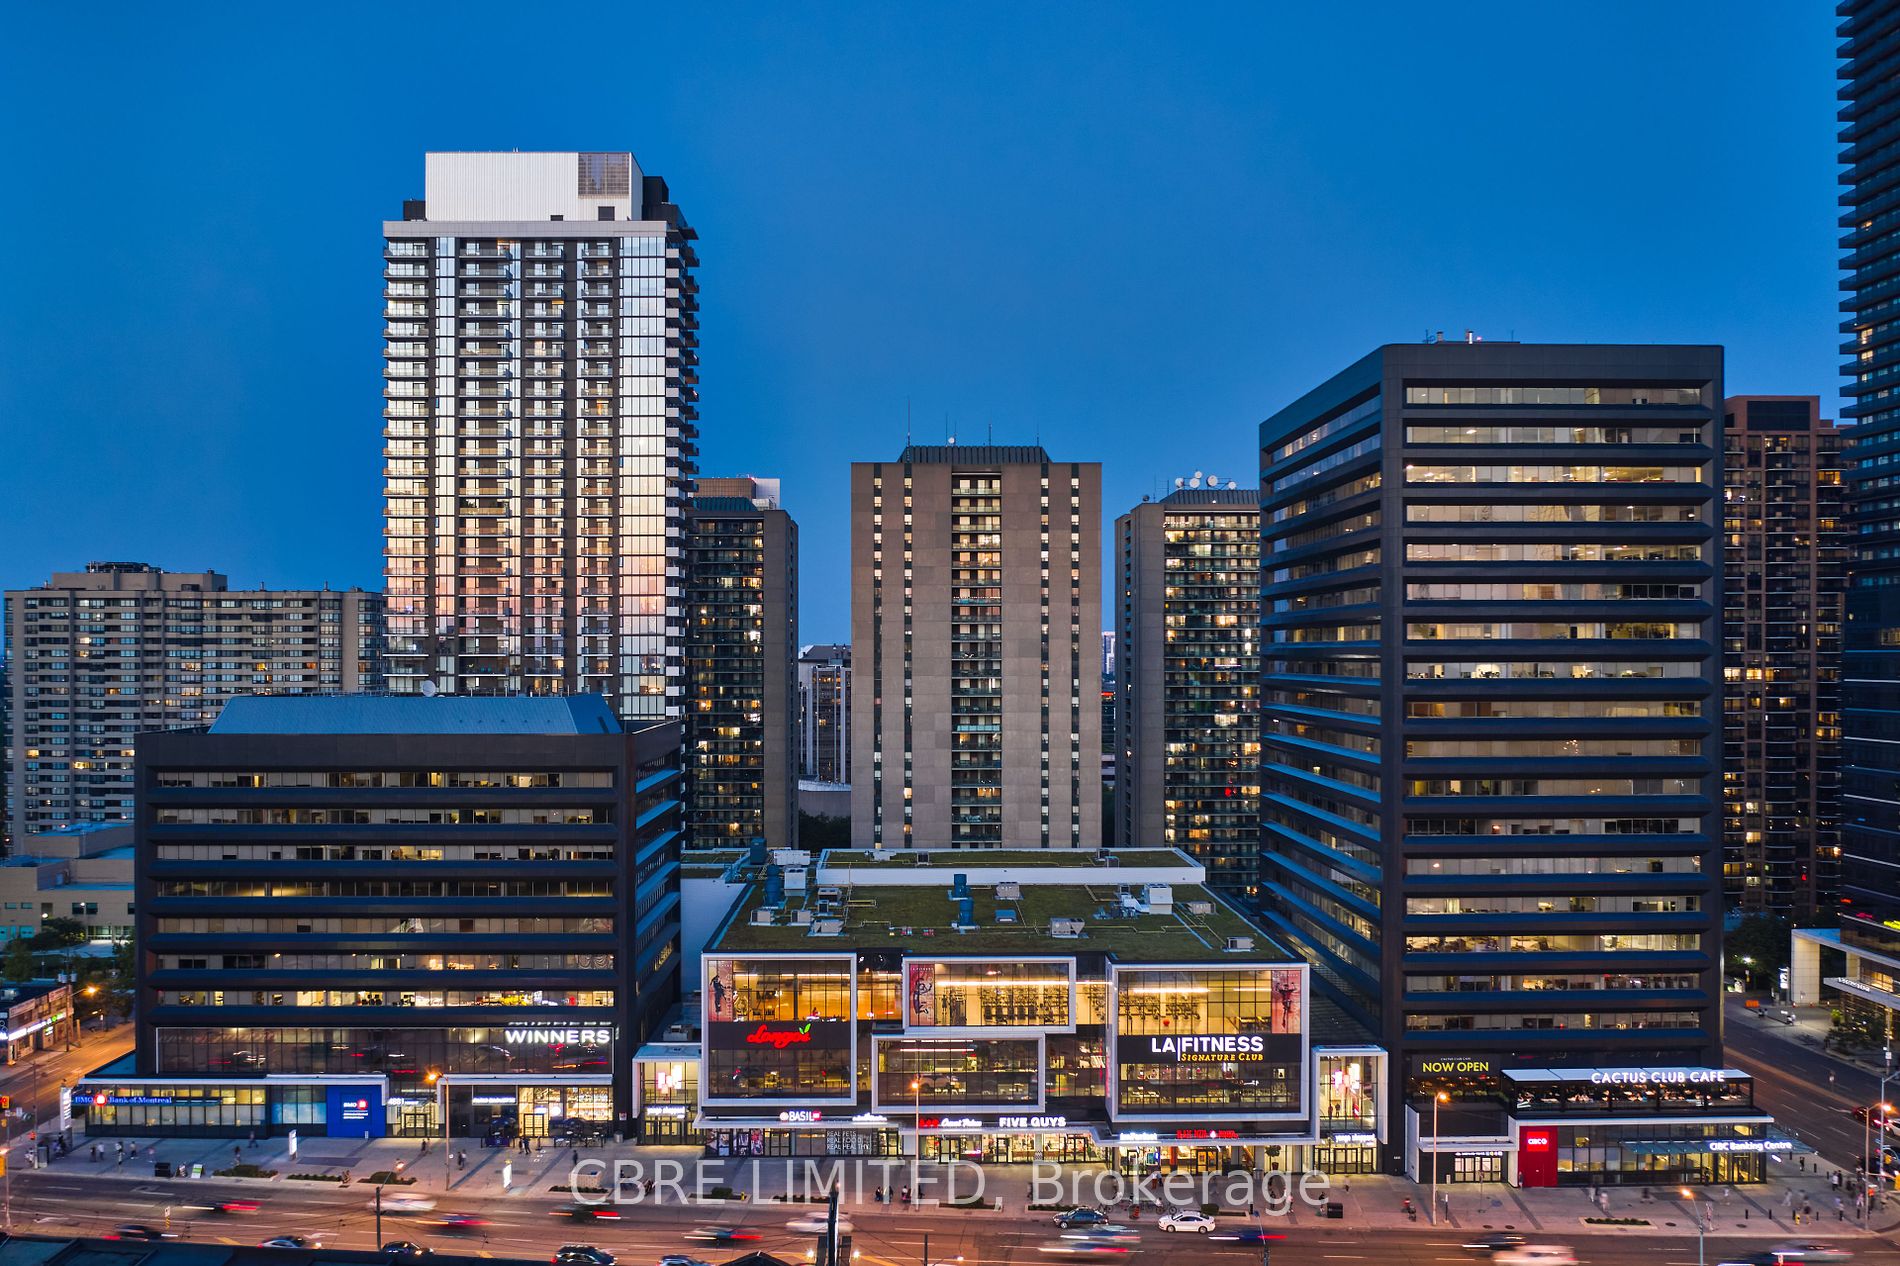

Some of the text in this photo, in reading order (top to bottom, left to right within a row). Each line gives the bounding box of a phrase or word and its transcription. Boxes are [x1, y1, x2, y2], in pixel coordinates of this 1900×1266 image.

[505, 1029, 610, 1044] WINNERS
[1181, 1053, 1264, 1062] SIGNATURE CLUB
[1422, 1061, 1489, 1072] NOW OPEN
[1591, 1071, 1725, 1083] CACTUS CLUB CAFE
[789, 1110, 814, 1121] BASIL
[999, 1117, 1067, 1127] FIVE GUYS
[1709, 1141, 1792, 1151] CIBC Banking Centre
